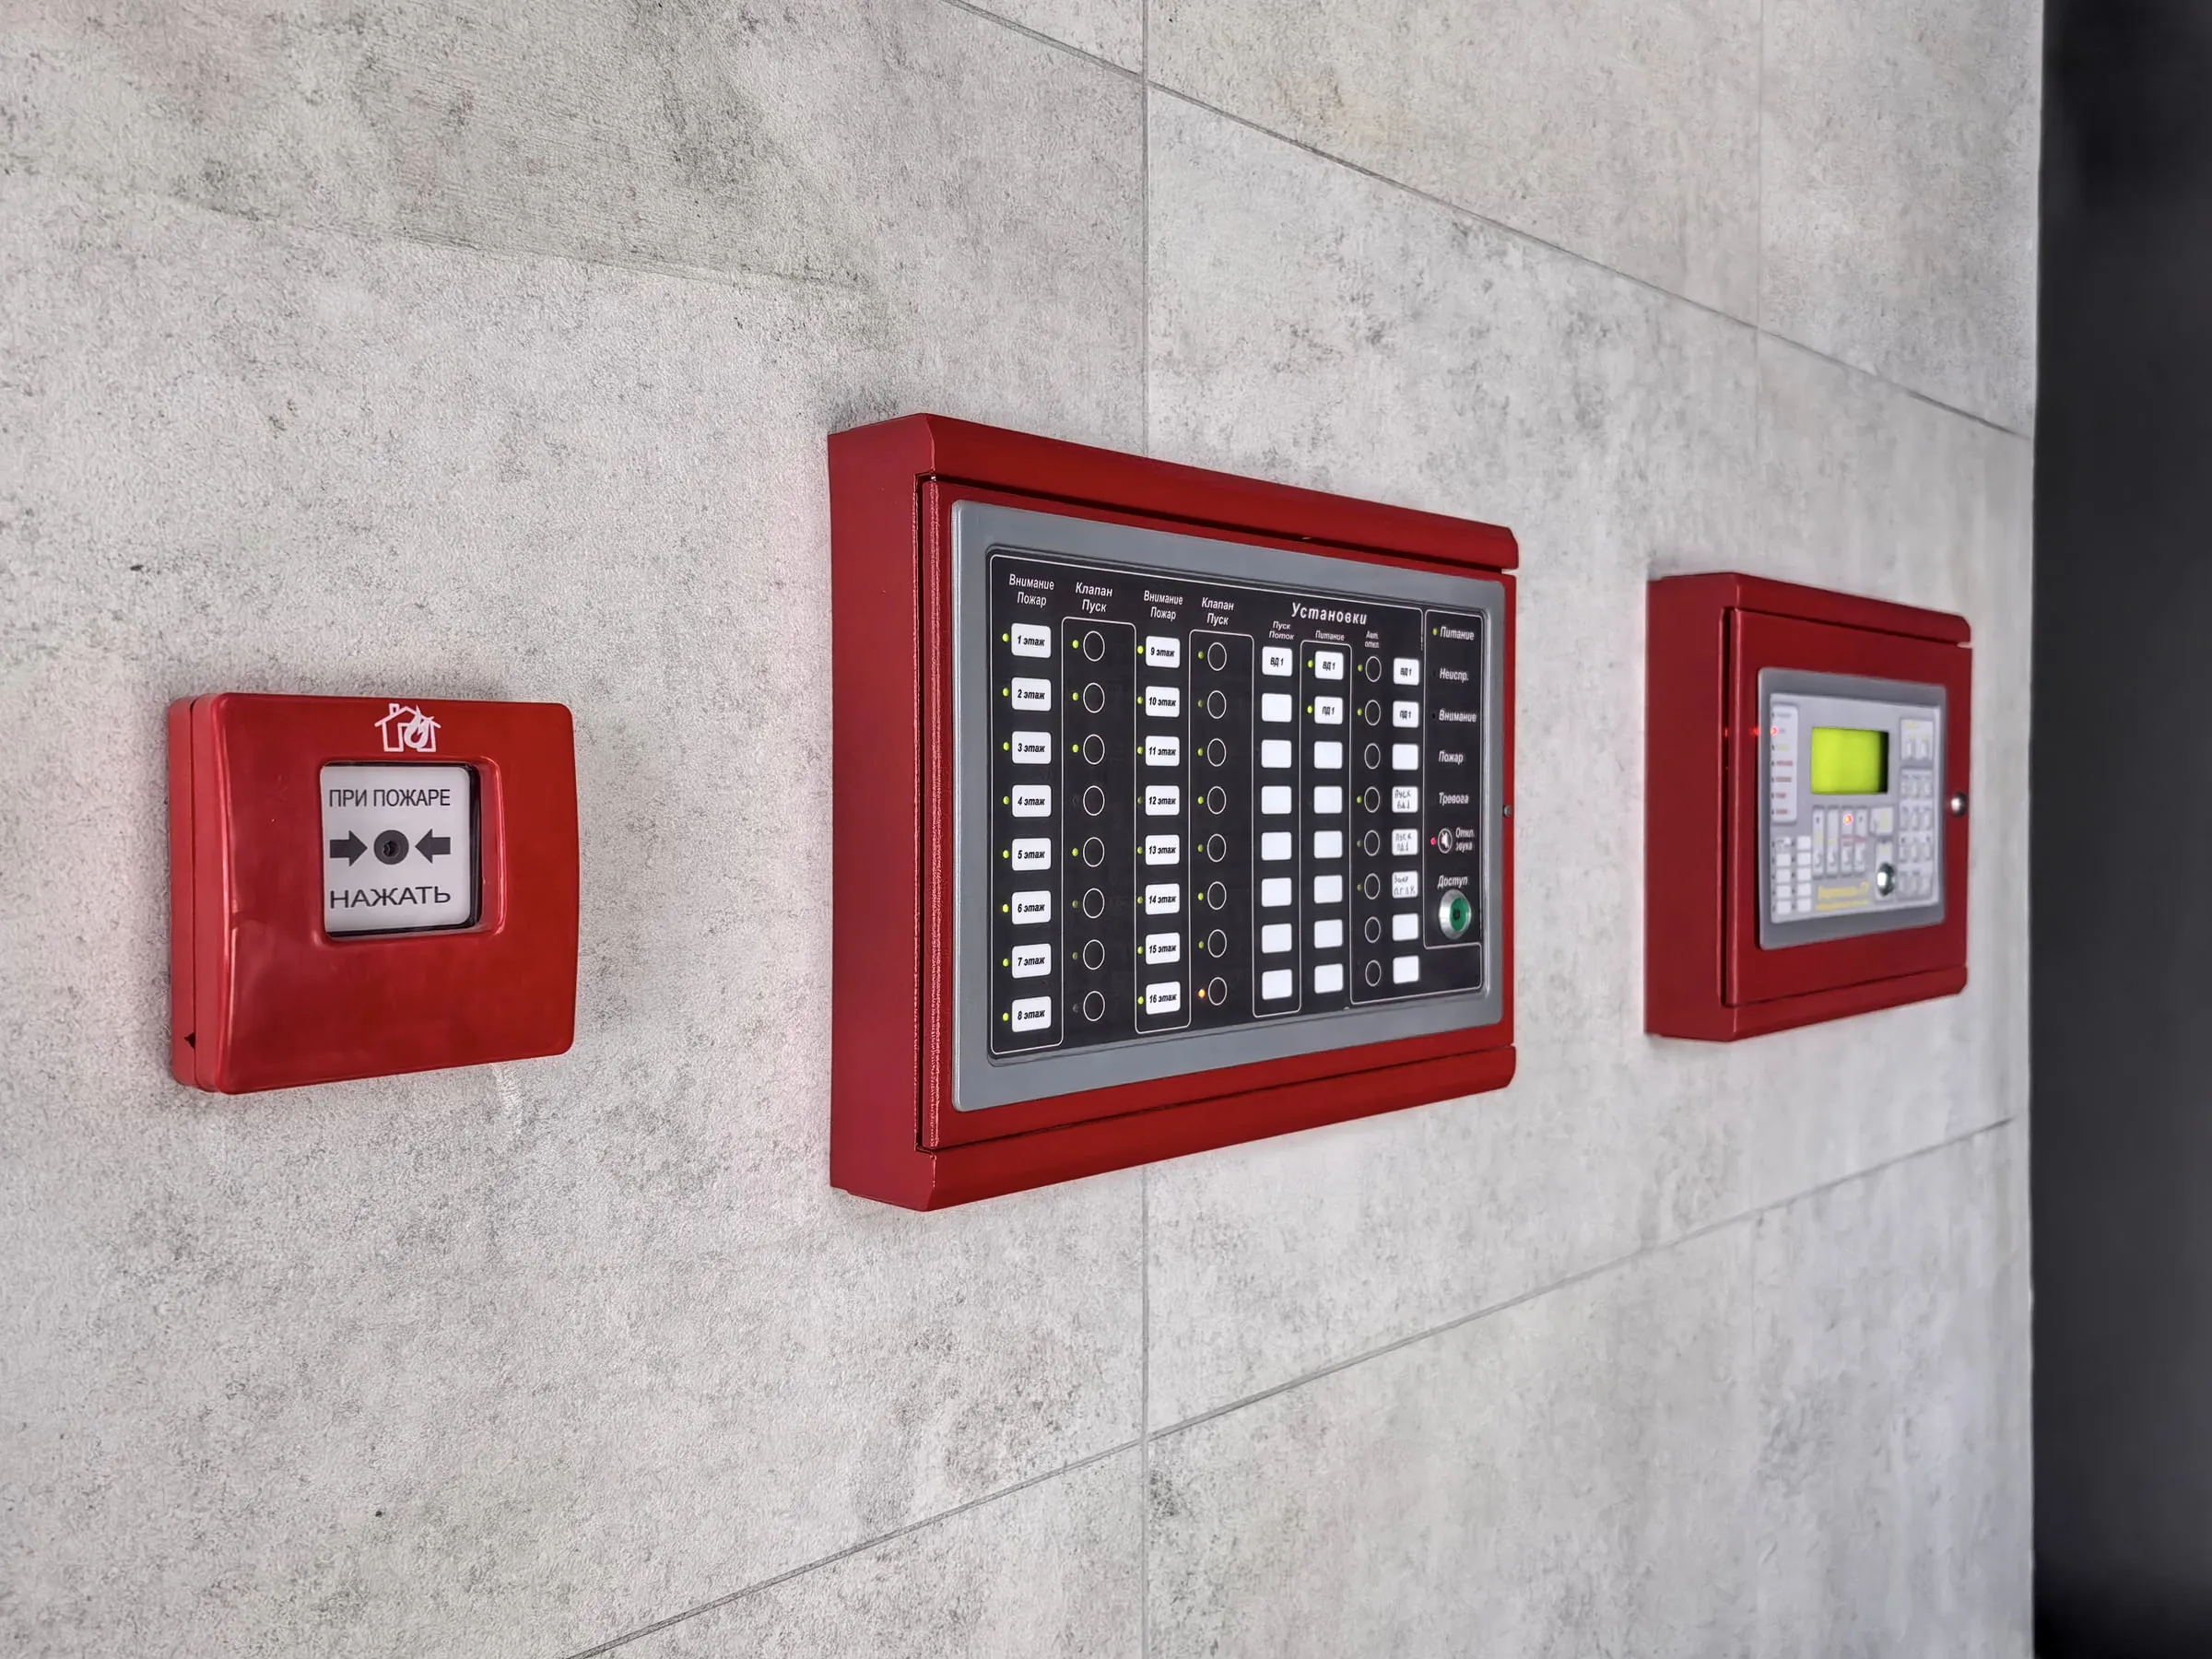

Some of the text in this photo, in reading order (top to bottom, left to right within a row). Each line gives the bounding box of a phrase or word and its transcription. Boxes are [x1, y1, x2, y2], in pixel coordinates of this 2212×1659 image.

[1009, 573, 1054, 591] Внимание
[1076, 582, 1112, 597] Клапан
[1018, 592, 1047, 607] Пожар
[1144, 590, 1183, 606] Внимание
[1081, 599, 1107, 613] Пуск
[1202, 597, 1234, 611] Клапан
[1150, 606, 1176, 621] Пожар
[1291, 602, 1367, 625] Установки
[1206, 613, 1229, 626] Пуск
[1273, 620, 1290, 629] Пуск
[1269, 630, 1294, 640] Поток
[1315, 630, 1345, 641] Питание
[1440, 627, 1474, 641] Питание
[1018, 635, 1045, 647] 1 этаж
[1150, 648, 1174, 657] 9 этаж
[1270, 657, 1279, 667] ВД
[1323, 661, 1331, 671] ВД
[1440, 669, 1468, 681] Неиспр.
[1018, 689, 1045, 700] 2 этаж
[1148, 697, 1176, 707] 10 этаж
[1439, 710, 1477, 723] Внимание
[1018, 744, 1045, 753] 3 этаж
[1148, 747, 1176, 756] 11 этаж
[1439, 750, 1463, 763] Пожар
[329, 789, 451, 807] ПРИ ПОЖАРЕ
[1018, 796, 1045, 806] 4 этаж
[1158, 797, 1176, 806] этаж
[1439, 792, 1468, 805] Тревога
[1018, 850, 1045, 859] 5 этаж
[1148, 846, 1176, 854] 13 этаж
[1438, 876, 1467, 888] Доступ
[330, 887, 451, 909] НАЖАТЬ
[1148, 895, 1176, 904] 14 этаж
[1018, 903, 1044, 912] 6 этаж
[1148, 944, 1176, 953] 15 этаж
[1024, 957, 1045, 966] этаж
[1148, 993, 1177, 1003] 16 этаж
[1018, 1010, 1045, 1019] 8 этаж
